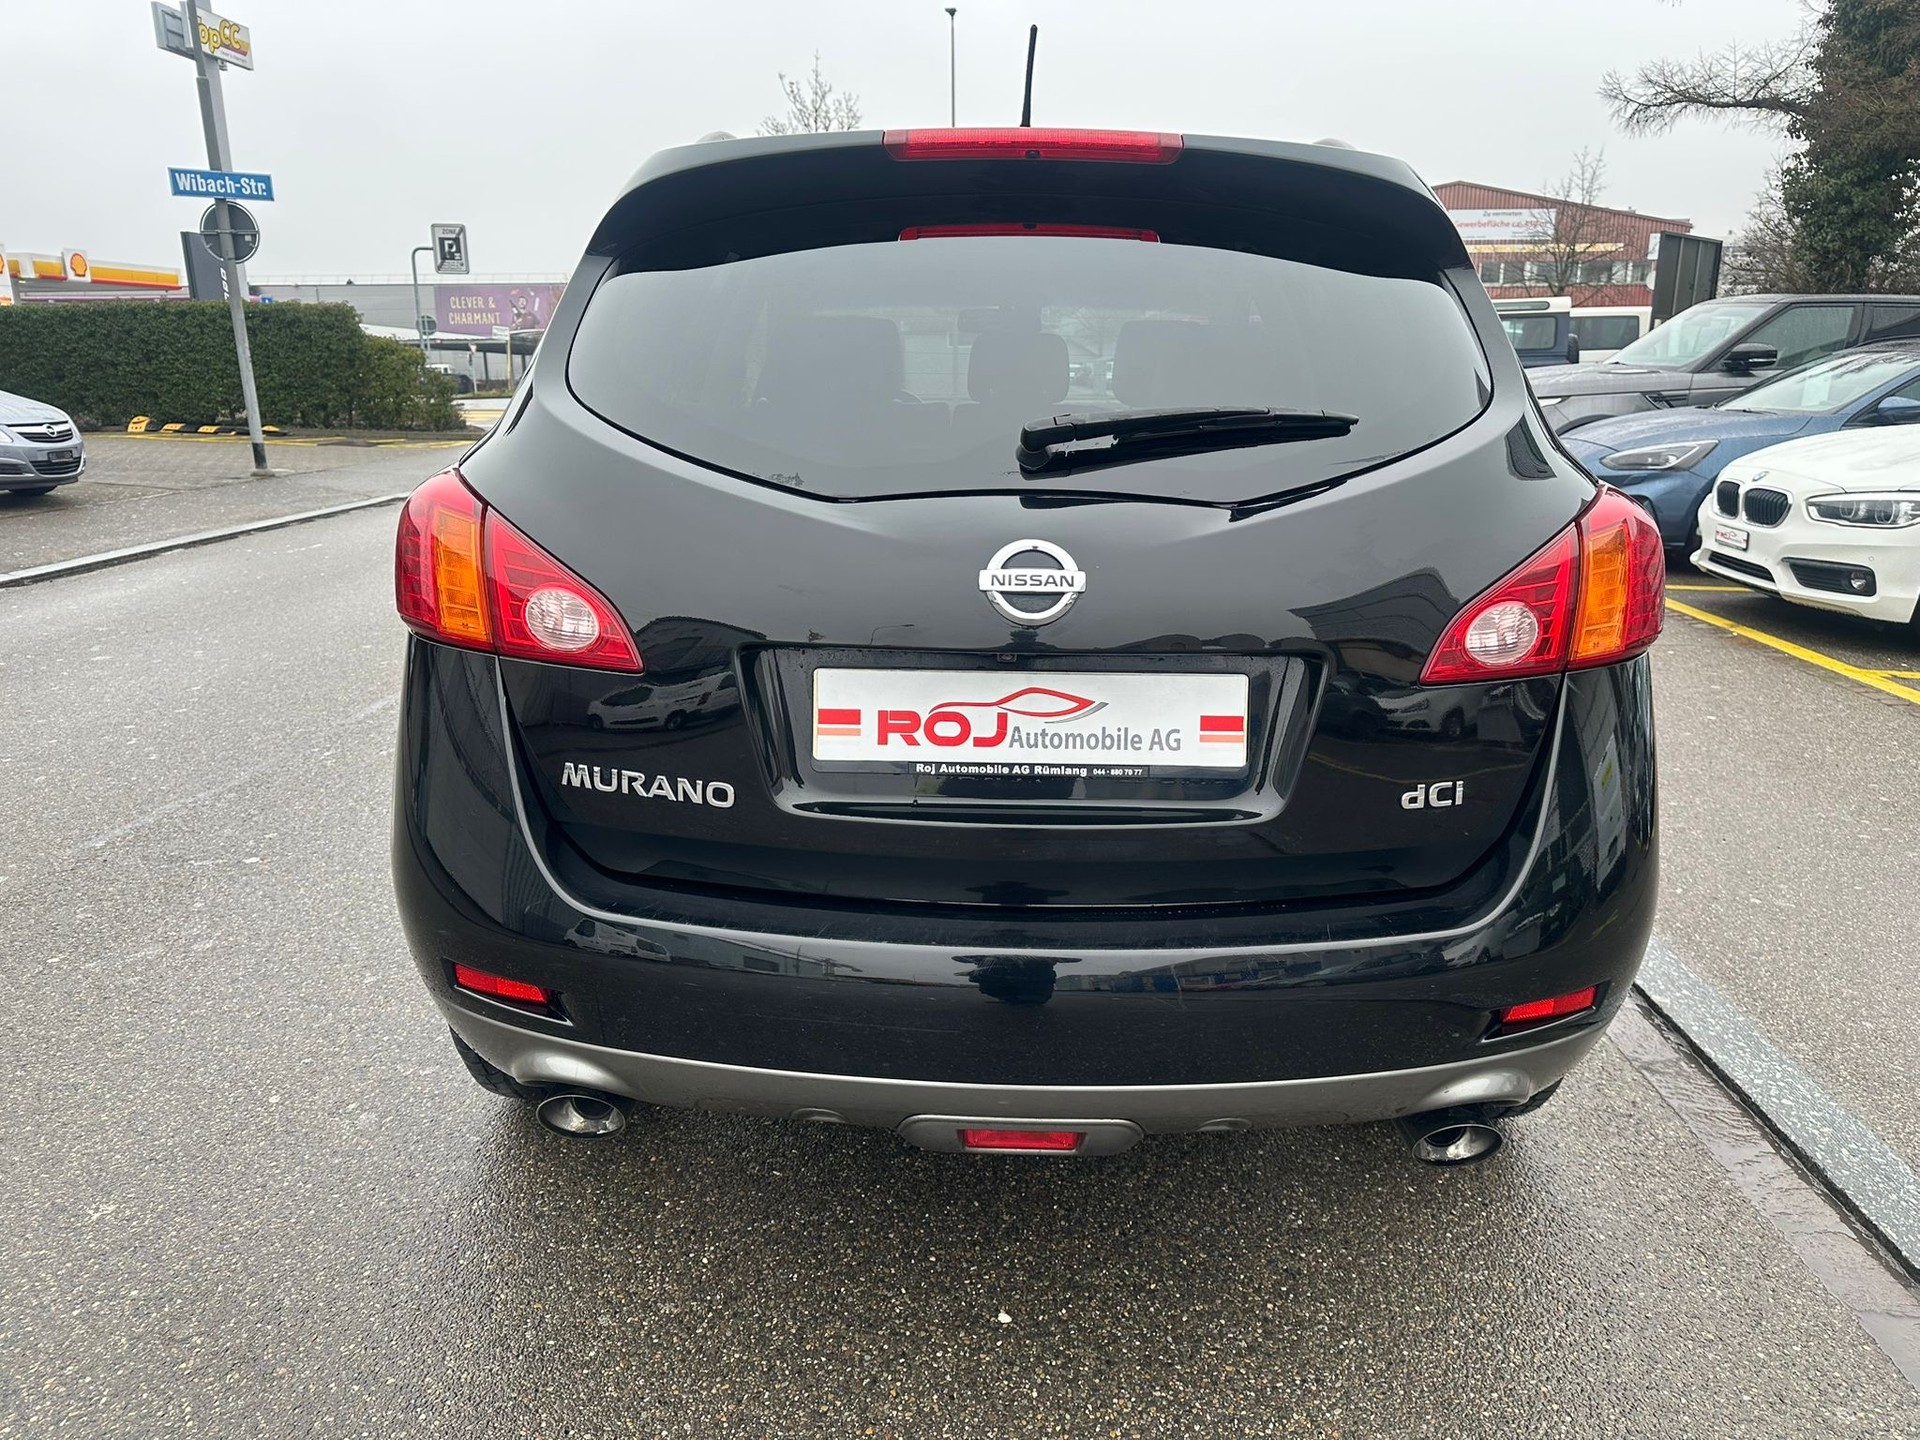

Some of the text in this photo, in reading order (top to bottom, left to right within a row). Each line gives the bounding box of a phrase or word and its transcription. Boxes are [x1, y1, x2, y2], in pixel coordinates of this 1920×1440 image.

[197, 16, 241, 53] opCC
[175, 172, 267, 196] Wibach-Str.
[449, 296, 496, 309] CLEVER &
[448, 312, 501, 325] CHARMANT
[990, 574, 1075, 587] NISSAN
[877, 709, 1182, 751] ROJ Automobile AG
[915, 763, 936, 775] Roj
[939, 764, 1010, 775] Automobile
[1012, 765, 1030, 775] AG
[1034, 765, 1088, 777] Rümlang
[561, 762, 735, 808] MURANO
[1401, 780, 1464, 809] dCi
